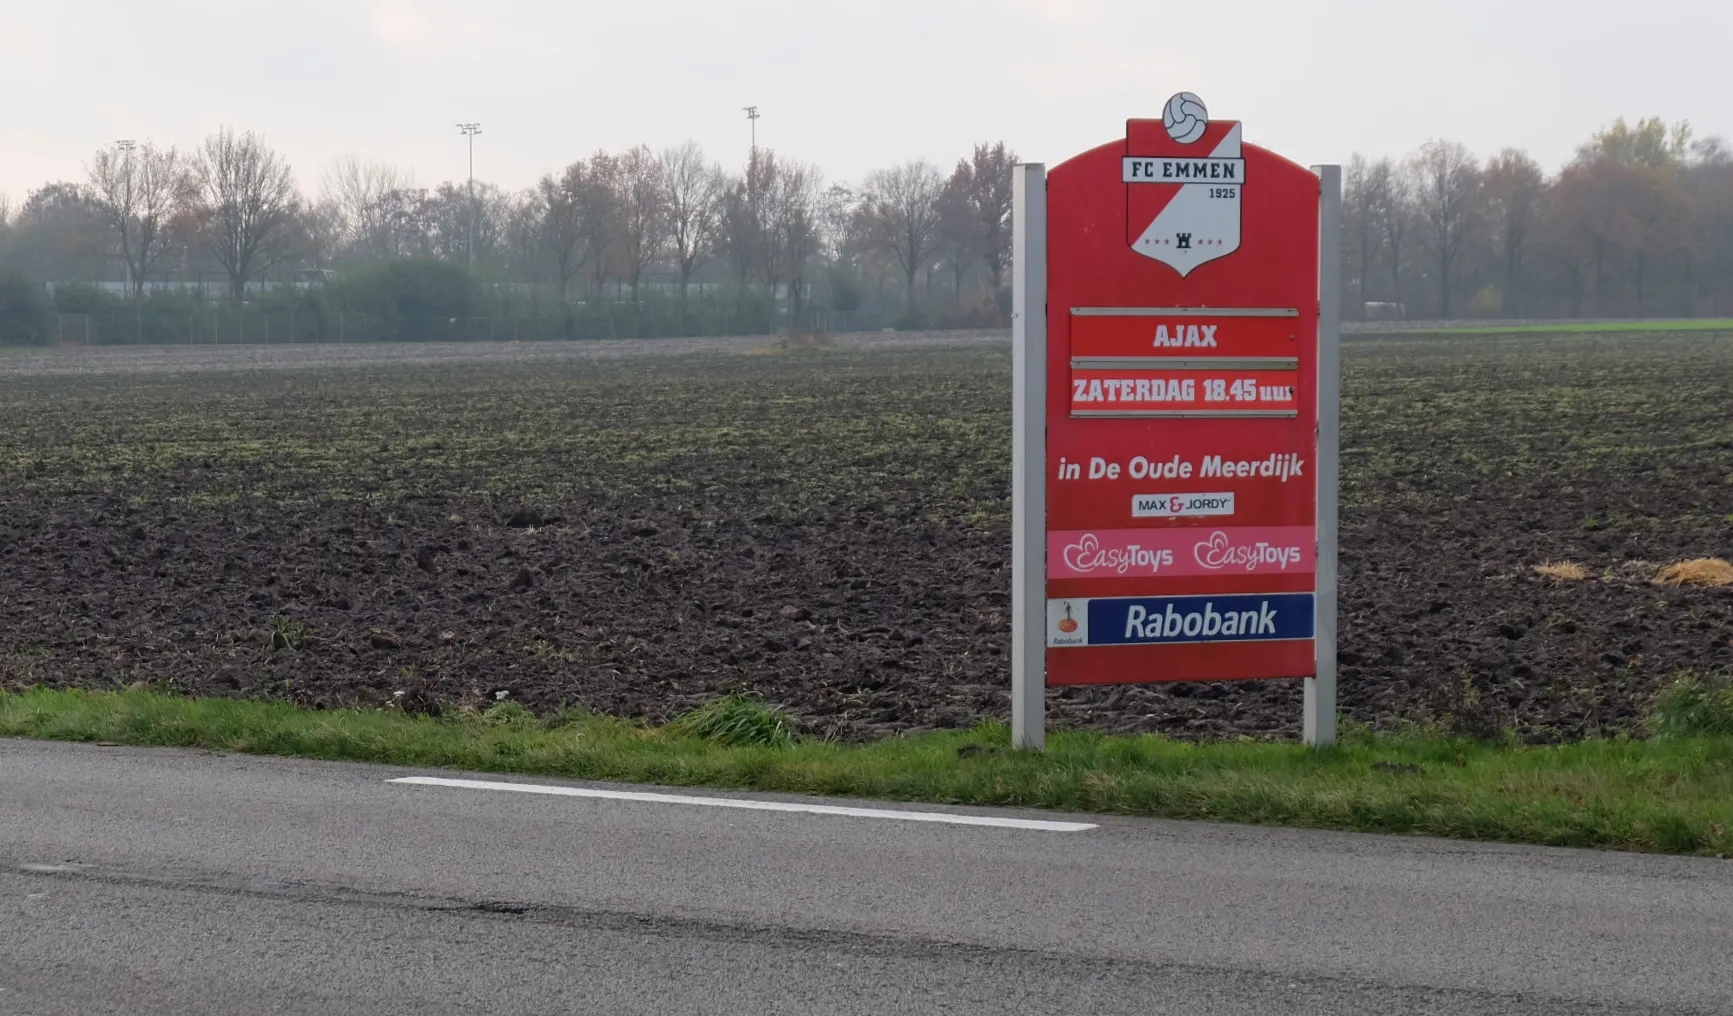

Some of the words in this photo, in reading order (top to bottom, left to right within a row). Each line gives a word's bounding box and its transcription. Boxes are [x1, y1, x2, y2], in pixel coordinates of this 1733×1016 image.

[1132, 161, 1154, 178] FC
[1162, 162, 1236, 179] EMMEN
[1209, 188, 1236, 199] 1925
[1153, 324, 1217, 347] AJAX
[1073, 379, 1195, 402] ZATERDAG
[1203, 379, 1256, 402] 18.45
[1058, 457, 1081, 480] in
[1088, 456, 1121, 480] De
[1128, 454, 1193, 479] Oude
[1199, 452, 1305, 483] Meerdijk
[1138, 499, 1167, 511] MAX
[1169, 496, 1184, 513] &
[1185, 498, 1228, 510] JORDY
[1063, 533, 1173, 574] EasyToys
[1194, 530, 1301, 570] EasyToys
[1124, 600, 1278, 639] Rabobank
[1053, 637, 1083, 645] Rabobank
